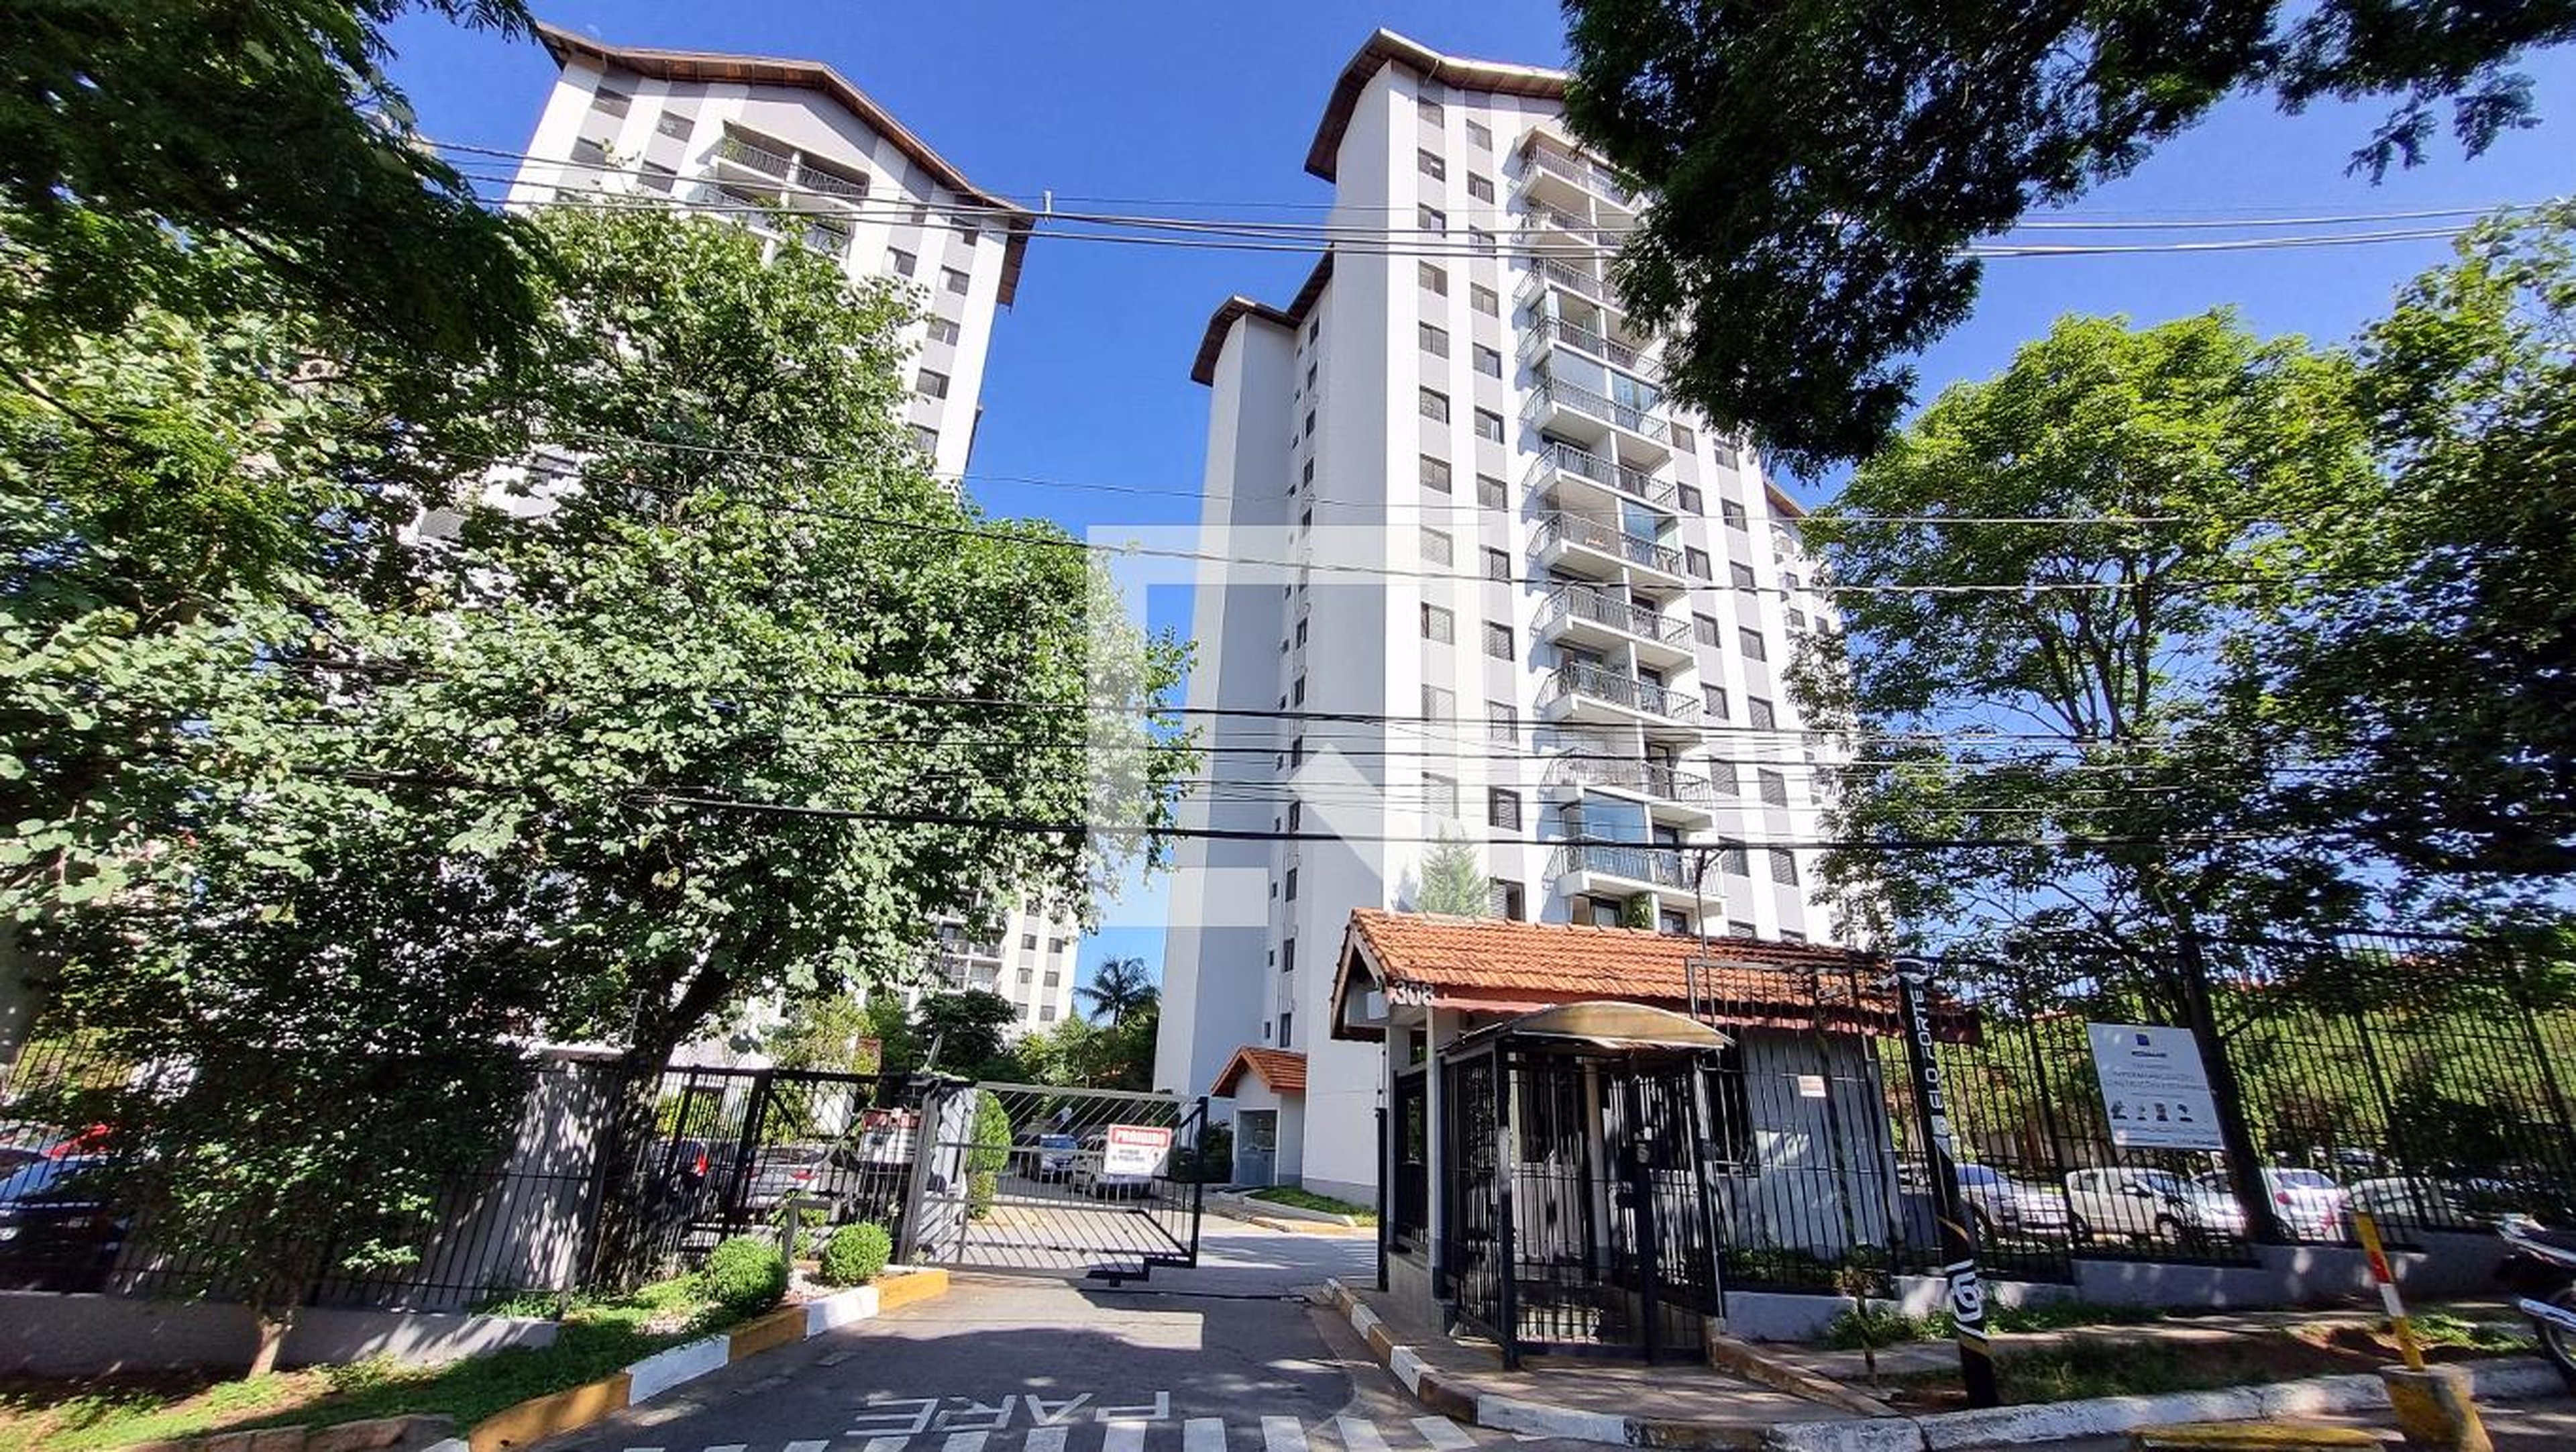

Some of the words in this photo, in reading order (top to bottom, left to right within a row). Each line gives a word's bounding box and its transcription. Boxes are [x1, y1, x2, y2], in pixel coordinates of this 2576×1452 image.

[1909, 989, 1935, 1061] FORTE
[1925, 1068, 1943, 1109] ELO
[846, 1391, 1169, 1436] PARE
